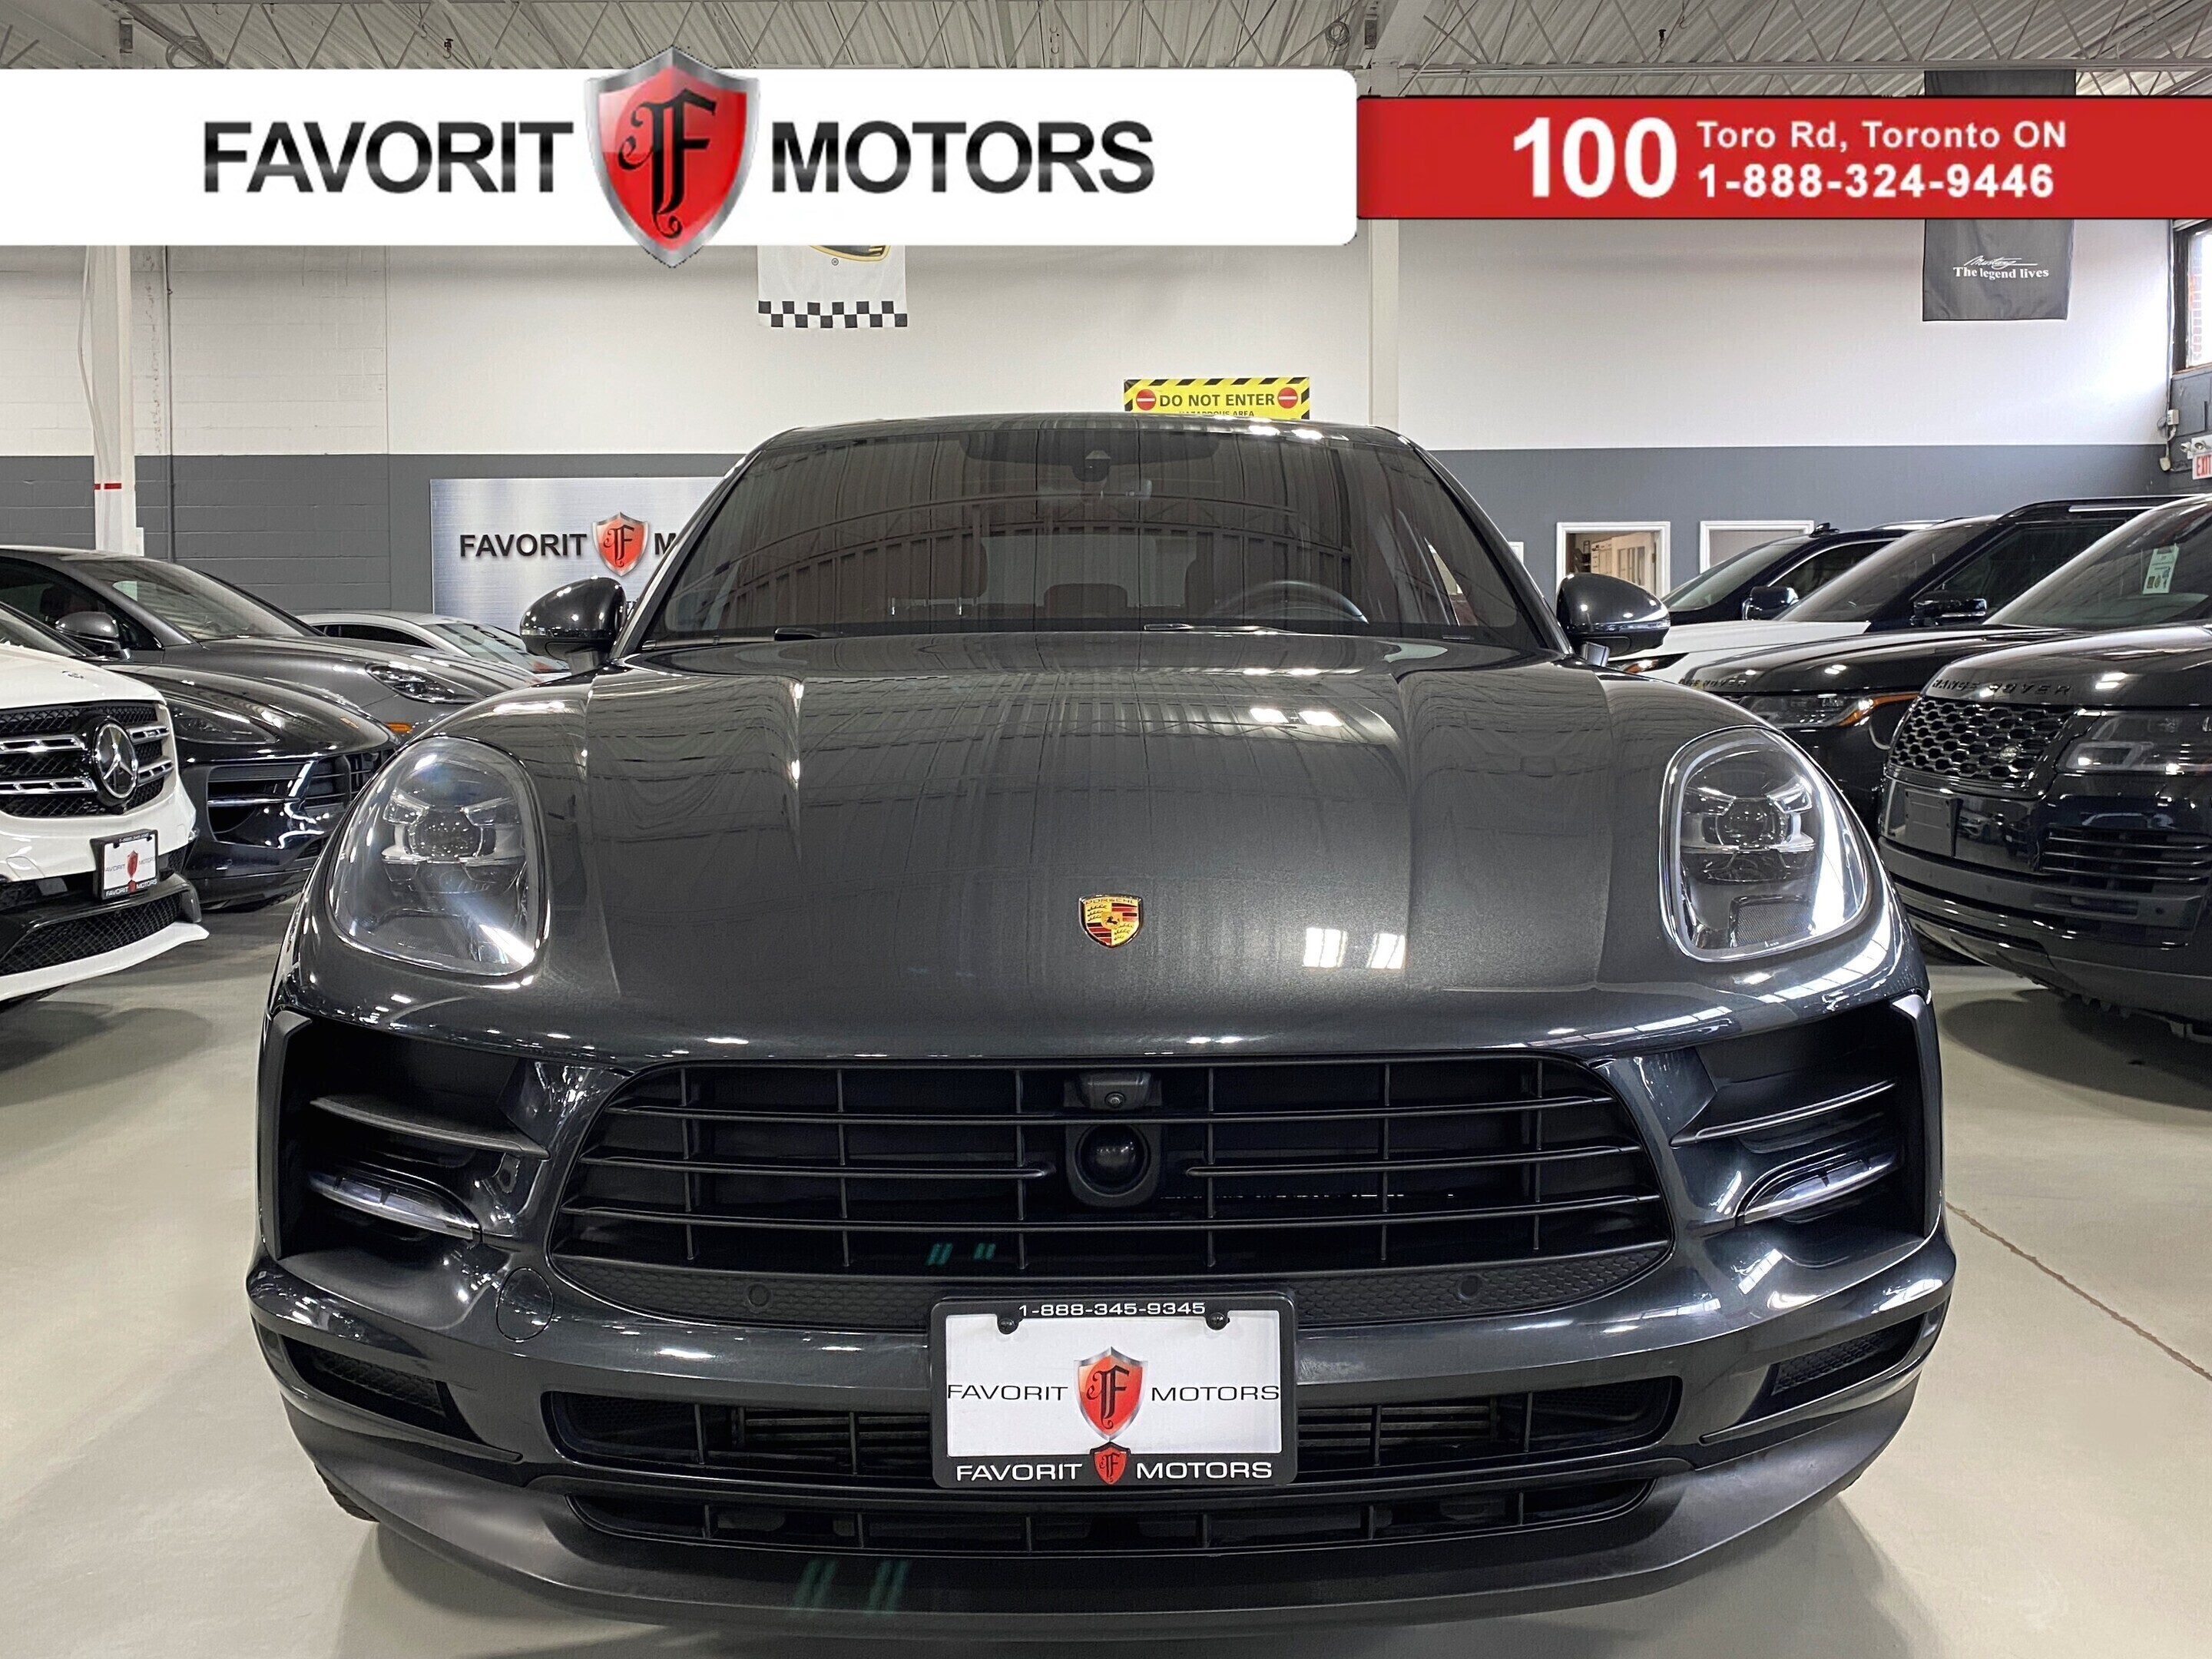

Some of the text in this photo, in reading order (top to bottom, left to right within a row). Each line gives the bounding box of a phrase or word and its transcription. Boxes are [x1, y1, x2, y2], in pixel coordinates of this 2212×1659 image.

[1952, 267, 2050, 280] The legend lives
[1160, 393, 1275, 407] DO NOT ENTER
[2197, 455, 2212, 476] EXIT
[459, 533, 588, 558] FAVORIT
[1988, 683, 2071, 695] ROVER
[1018, 1302, 1206, 1316] 1-888-345-9345
[947, 1384, 1068, 1402] FAVORIT
[1151, 1385, 1280, 1402] MOTORS
[956, 1463, 1083, 1482] FAVORIT
[1137, 1462, 1273, 1479] MOTORS
